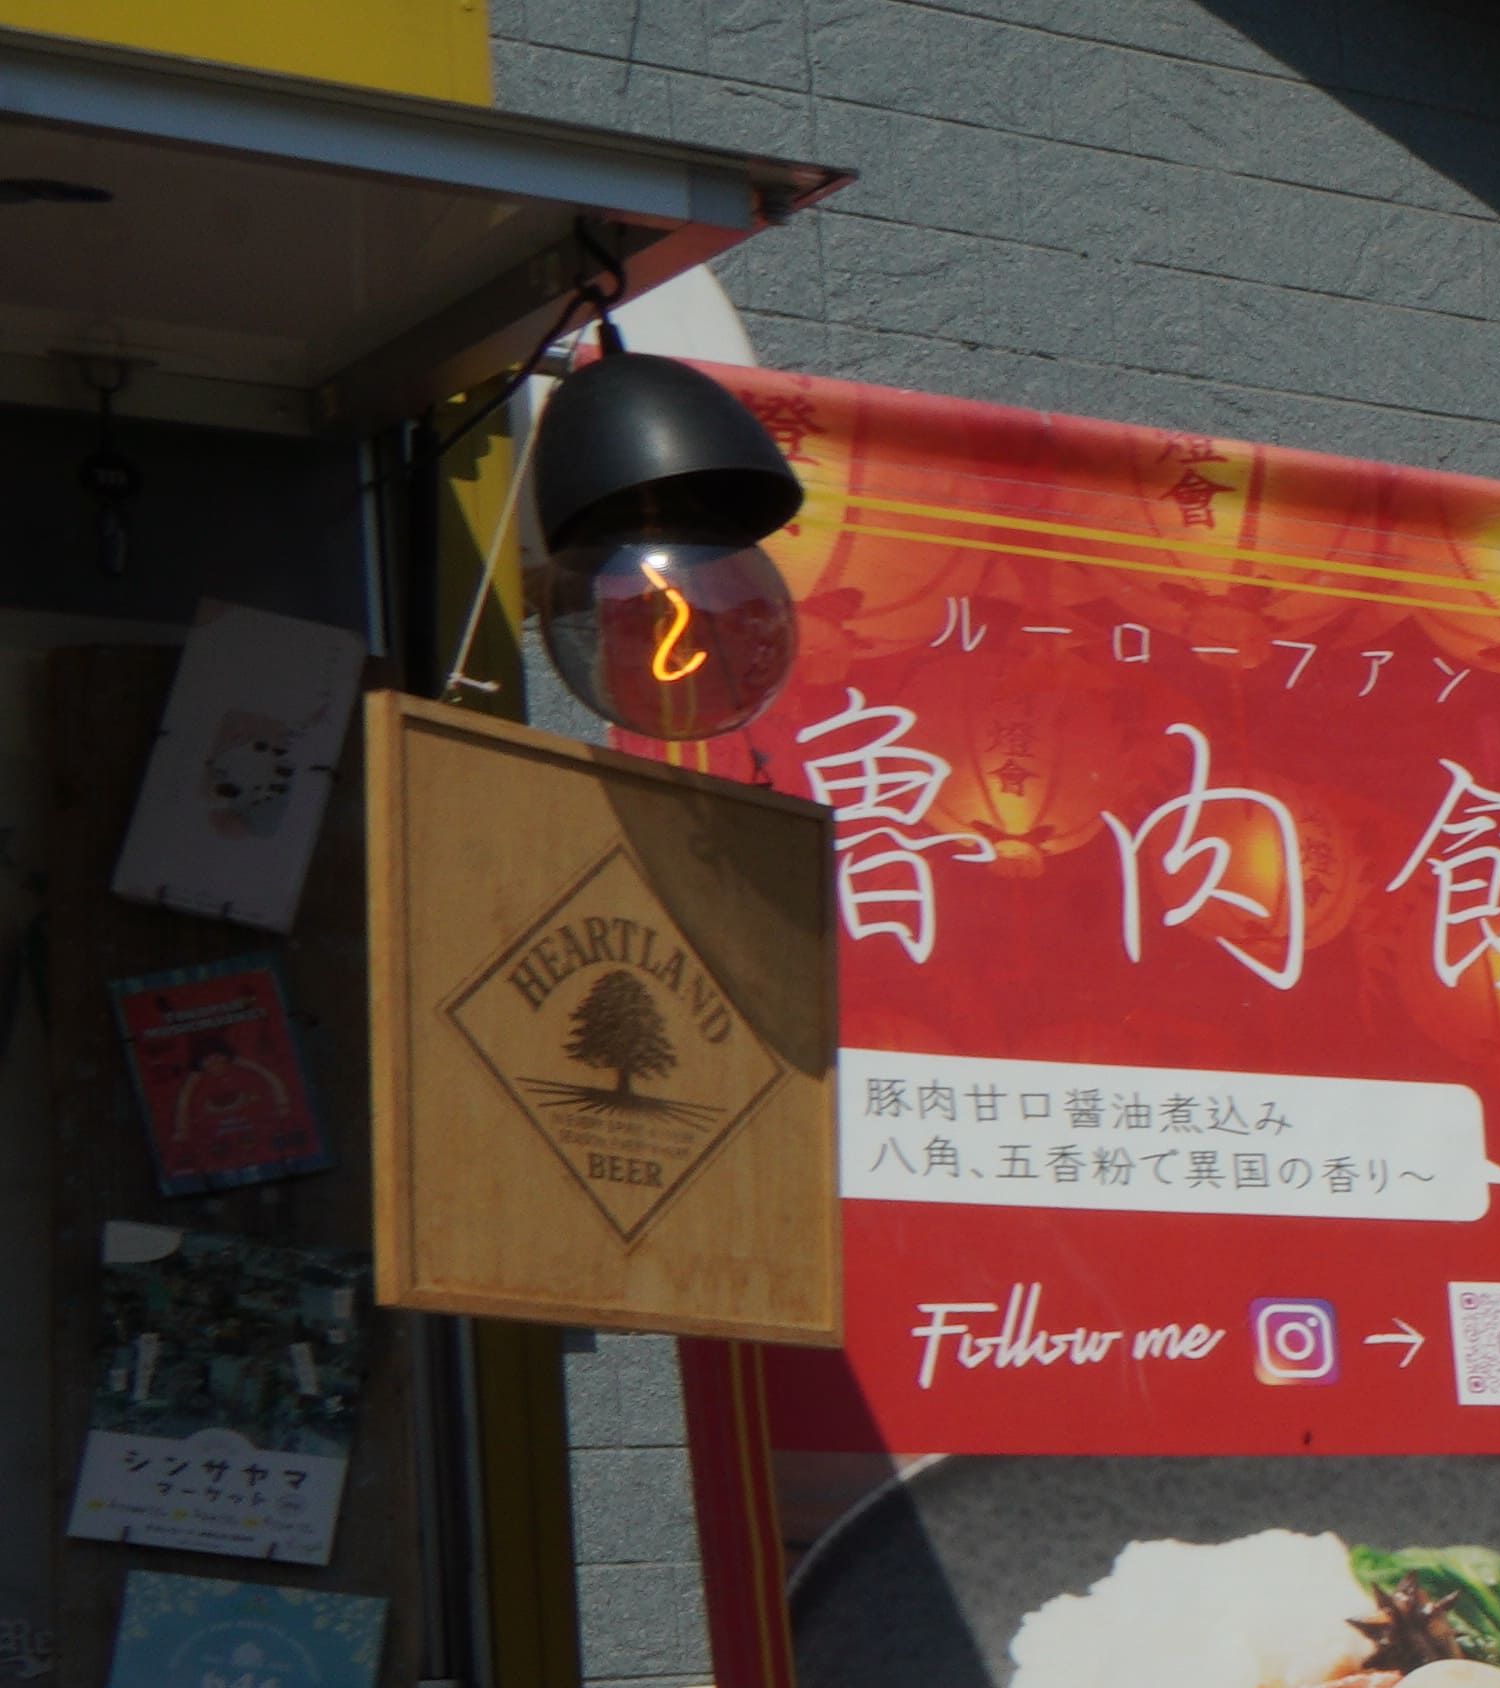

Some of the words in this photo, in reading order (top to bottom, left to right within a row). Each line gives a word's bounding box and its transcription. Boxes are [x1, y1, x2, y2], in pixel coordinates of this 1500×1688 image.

[929, 596, 1470, 702] ルーローファン
[507, 916, 732, 1044] HEARTLAND
[864, 1077, 1294, 1138] 豚肉甘口醤油煮込み
[588, 1152, 664, 1188] BEER
[911, 1282, 1123, 1389] Follow
[1131, 1323, 1227, 1360] me
